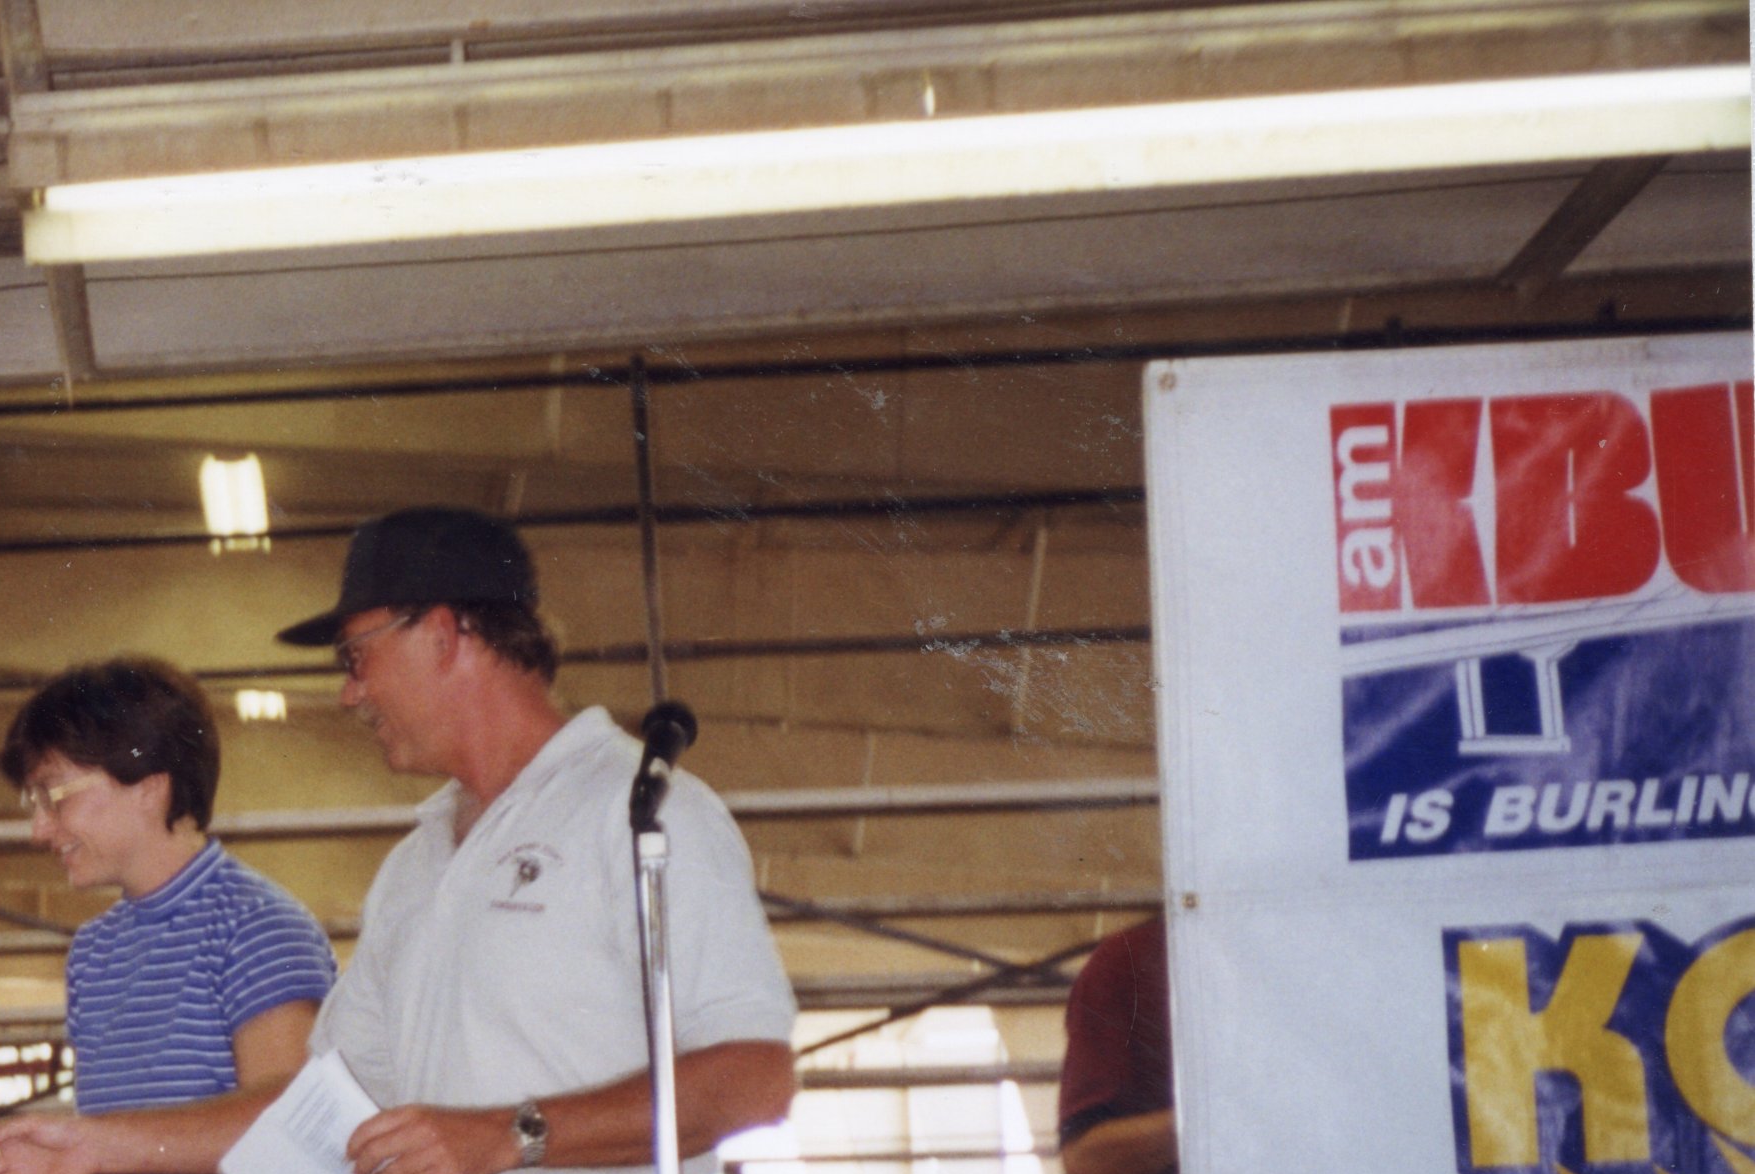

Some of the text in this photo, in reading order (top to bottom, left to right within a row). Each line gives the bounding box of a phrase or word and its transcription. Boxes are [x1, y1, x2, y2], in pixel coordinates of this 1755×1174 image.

[1338, 424, 1395, 590] am
[1380, 772, 1754, 844] IS BURLIN
